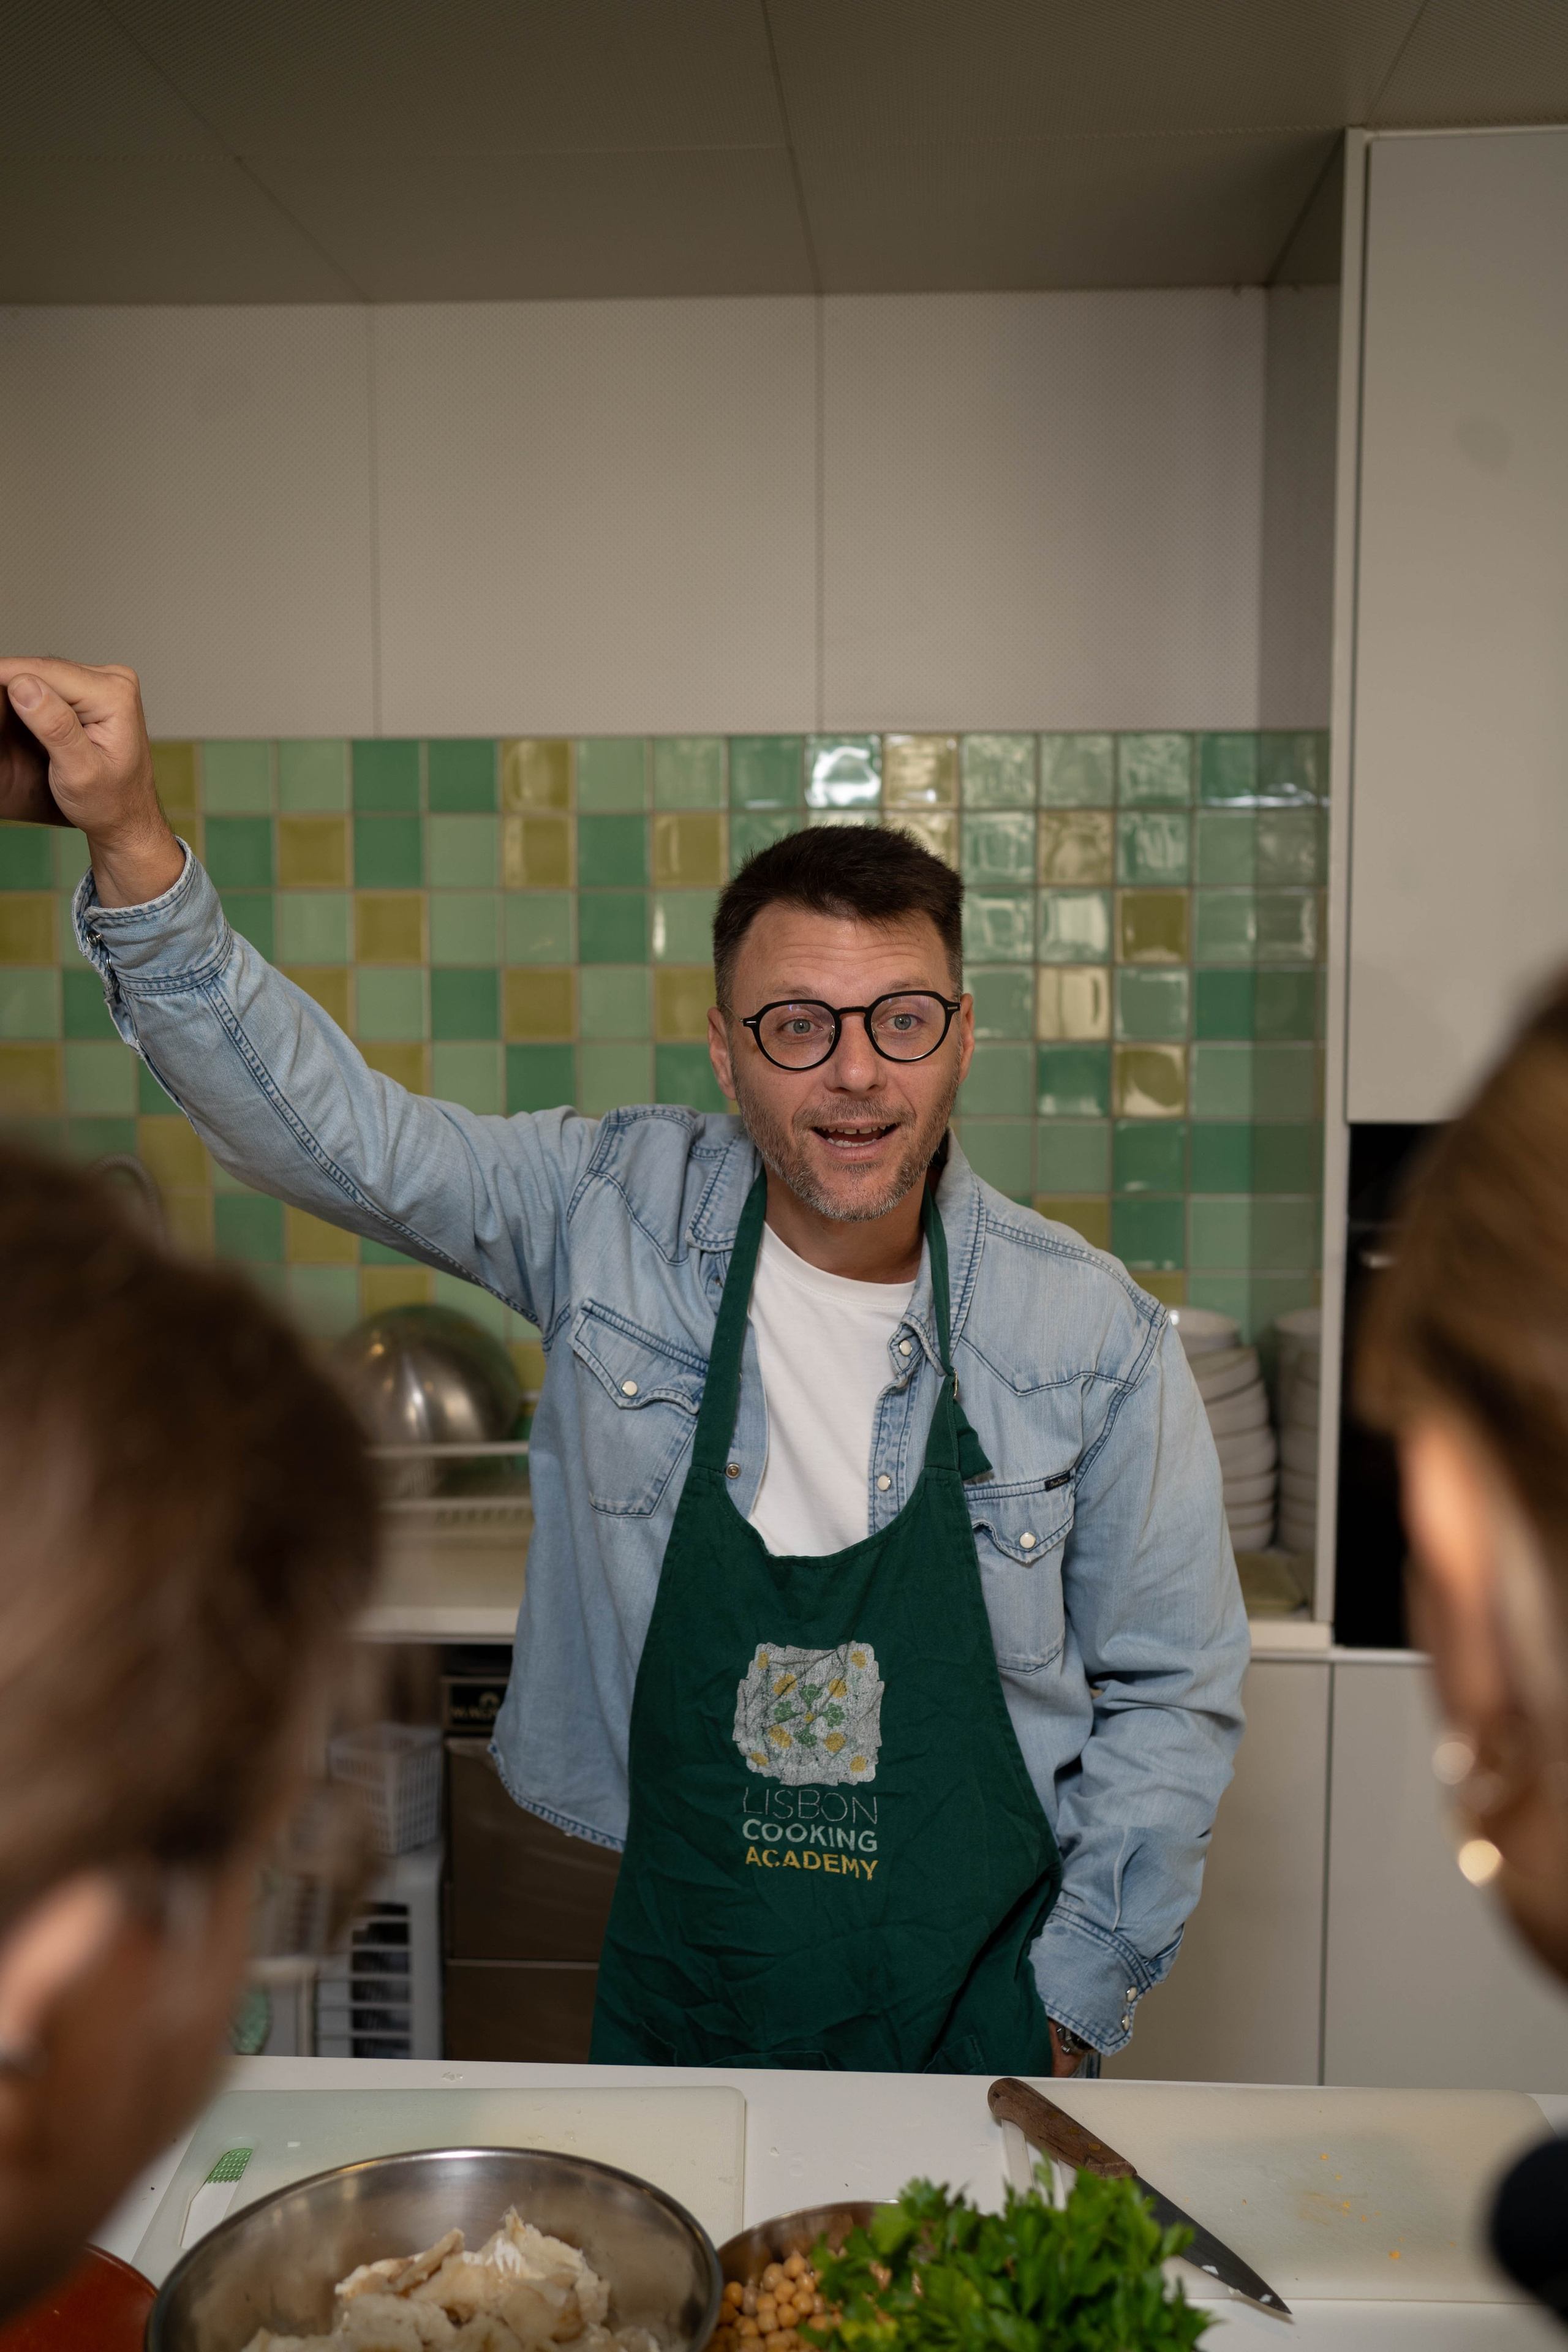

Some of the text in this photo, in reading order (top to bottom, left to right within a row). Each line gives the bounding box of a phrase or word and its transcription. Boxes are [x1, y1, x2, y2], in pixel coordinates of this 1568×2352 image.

[743, 1787, 878, 1825] LISBON
[742, 1819, 878, 1852] COOKING
[745, 1846, 878, 1880] ACADEMY
